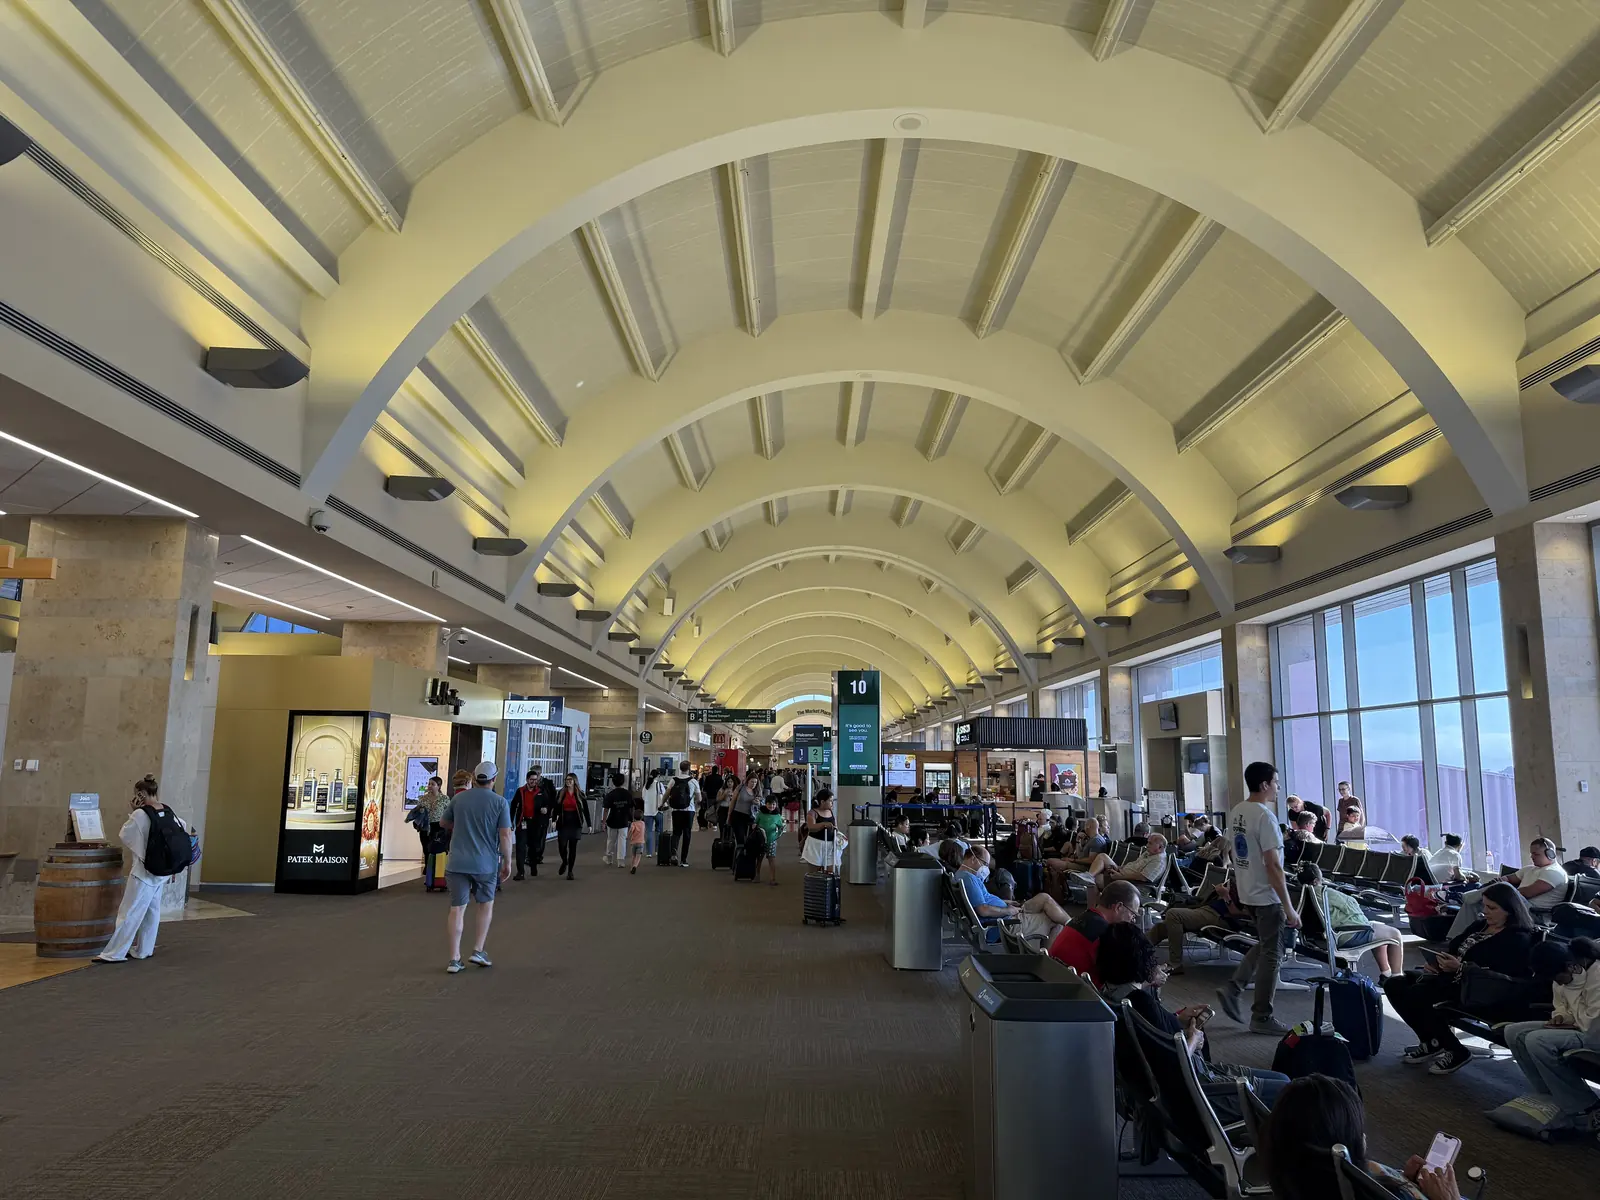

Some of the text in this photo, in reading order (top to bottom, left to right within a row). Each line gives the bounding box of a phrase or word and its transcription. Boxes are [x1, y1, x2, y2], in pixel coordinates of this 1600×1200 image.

[850, 680, 866, 694] 10
[506, 704, 514, 714] La
[287, 856, 313, 864] PATEK
